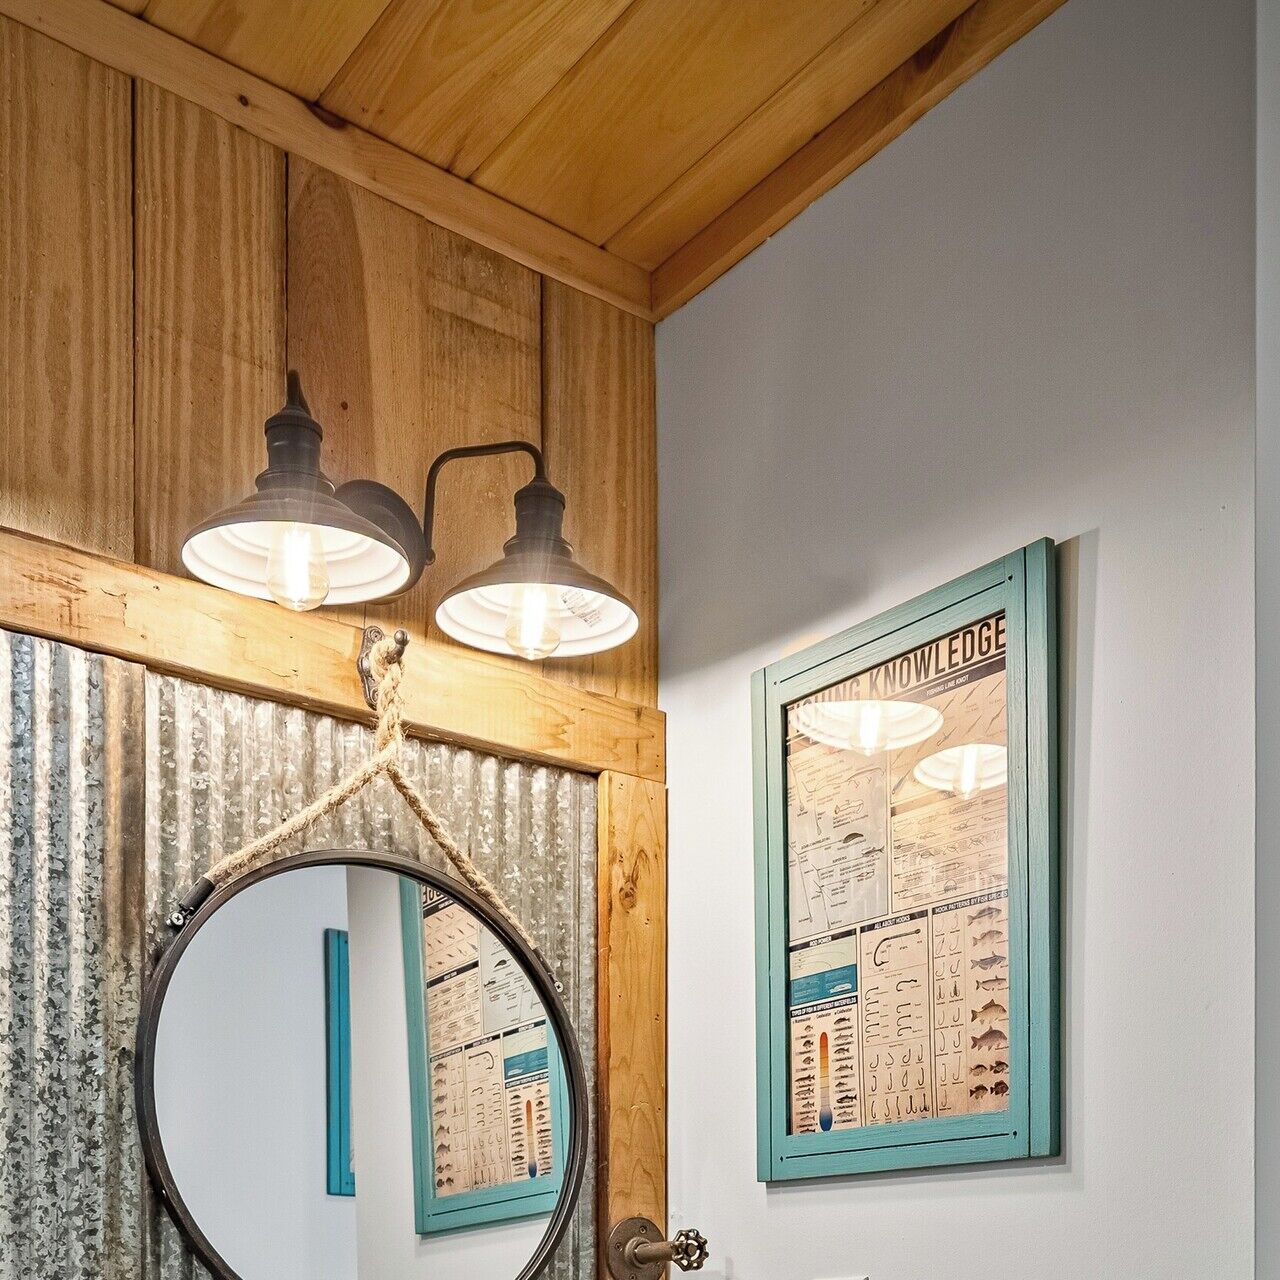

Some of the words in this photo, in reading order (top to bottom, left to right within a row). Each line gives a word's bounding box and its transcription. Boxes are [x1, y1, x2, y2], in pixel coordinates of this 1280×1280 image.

[870, 614, 1006, 700] KNOWLEDGE
[935, 906, 949, 914] HOOK
[948, 899, 970, 911] PATTERNS
[970, 898, 978, 906] BY
[988, 890, 1008, 901] SPECIES
